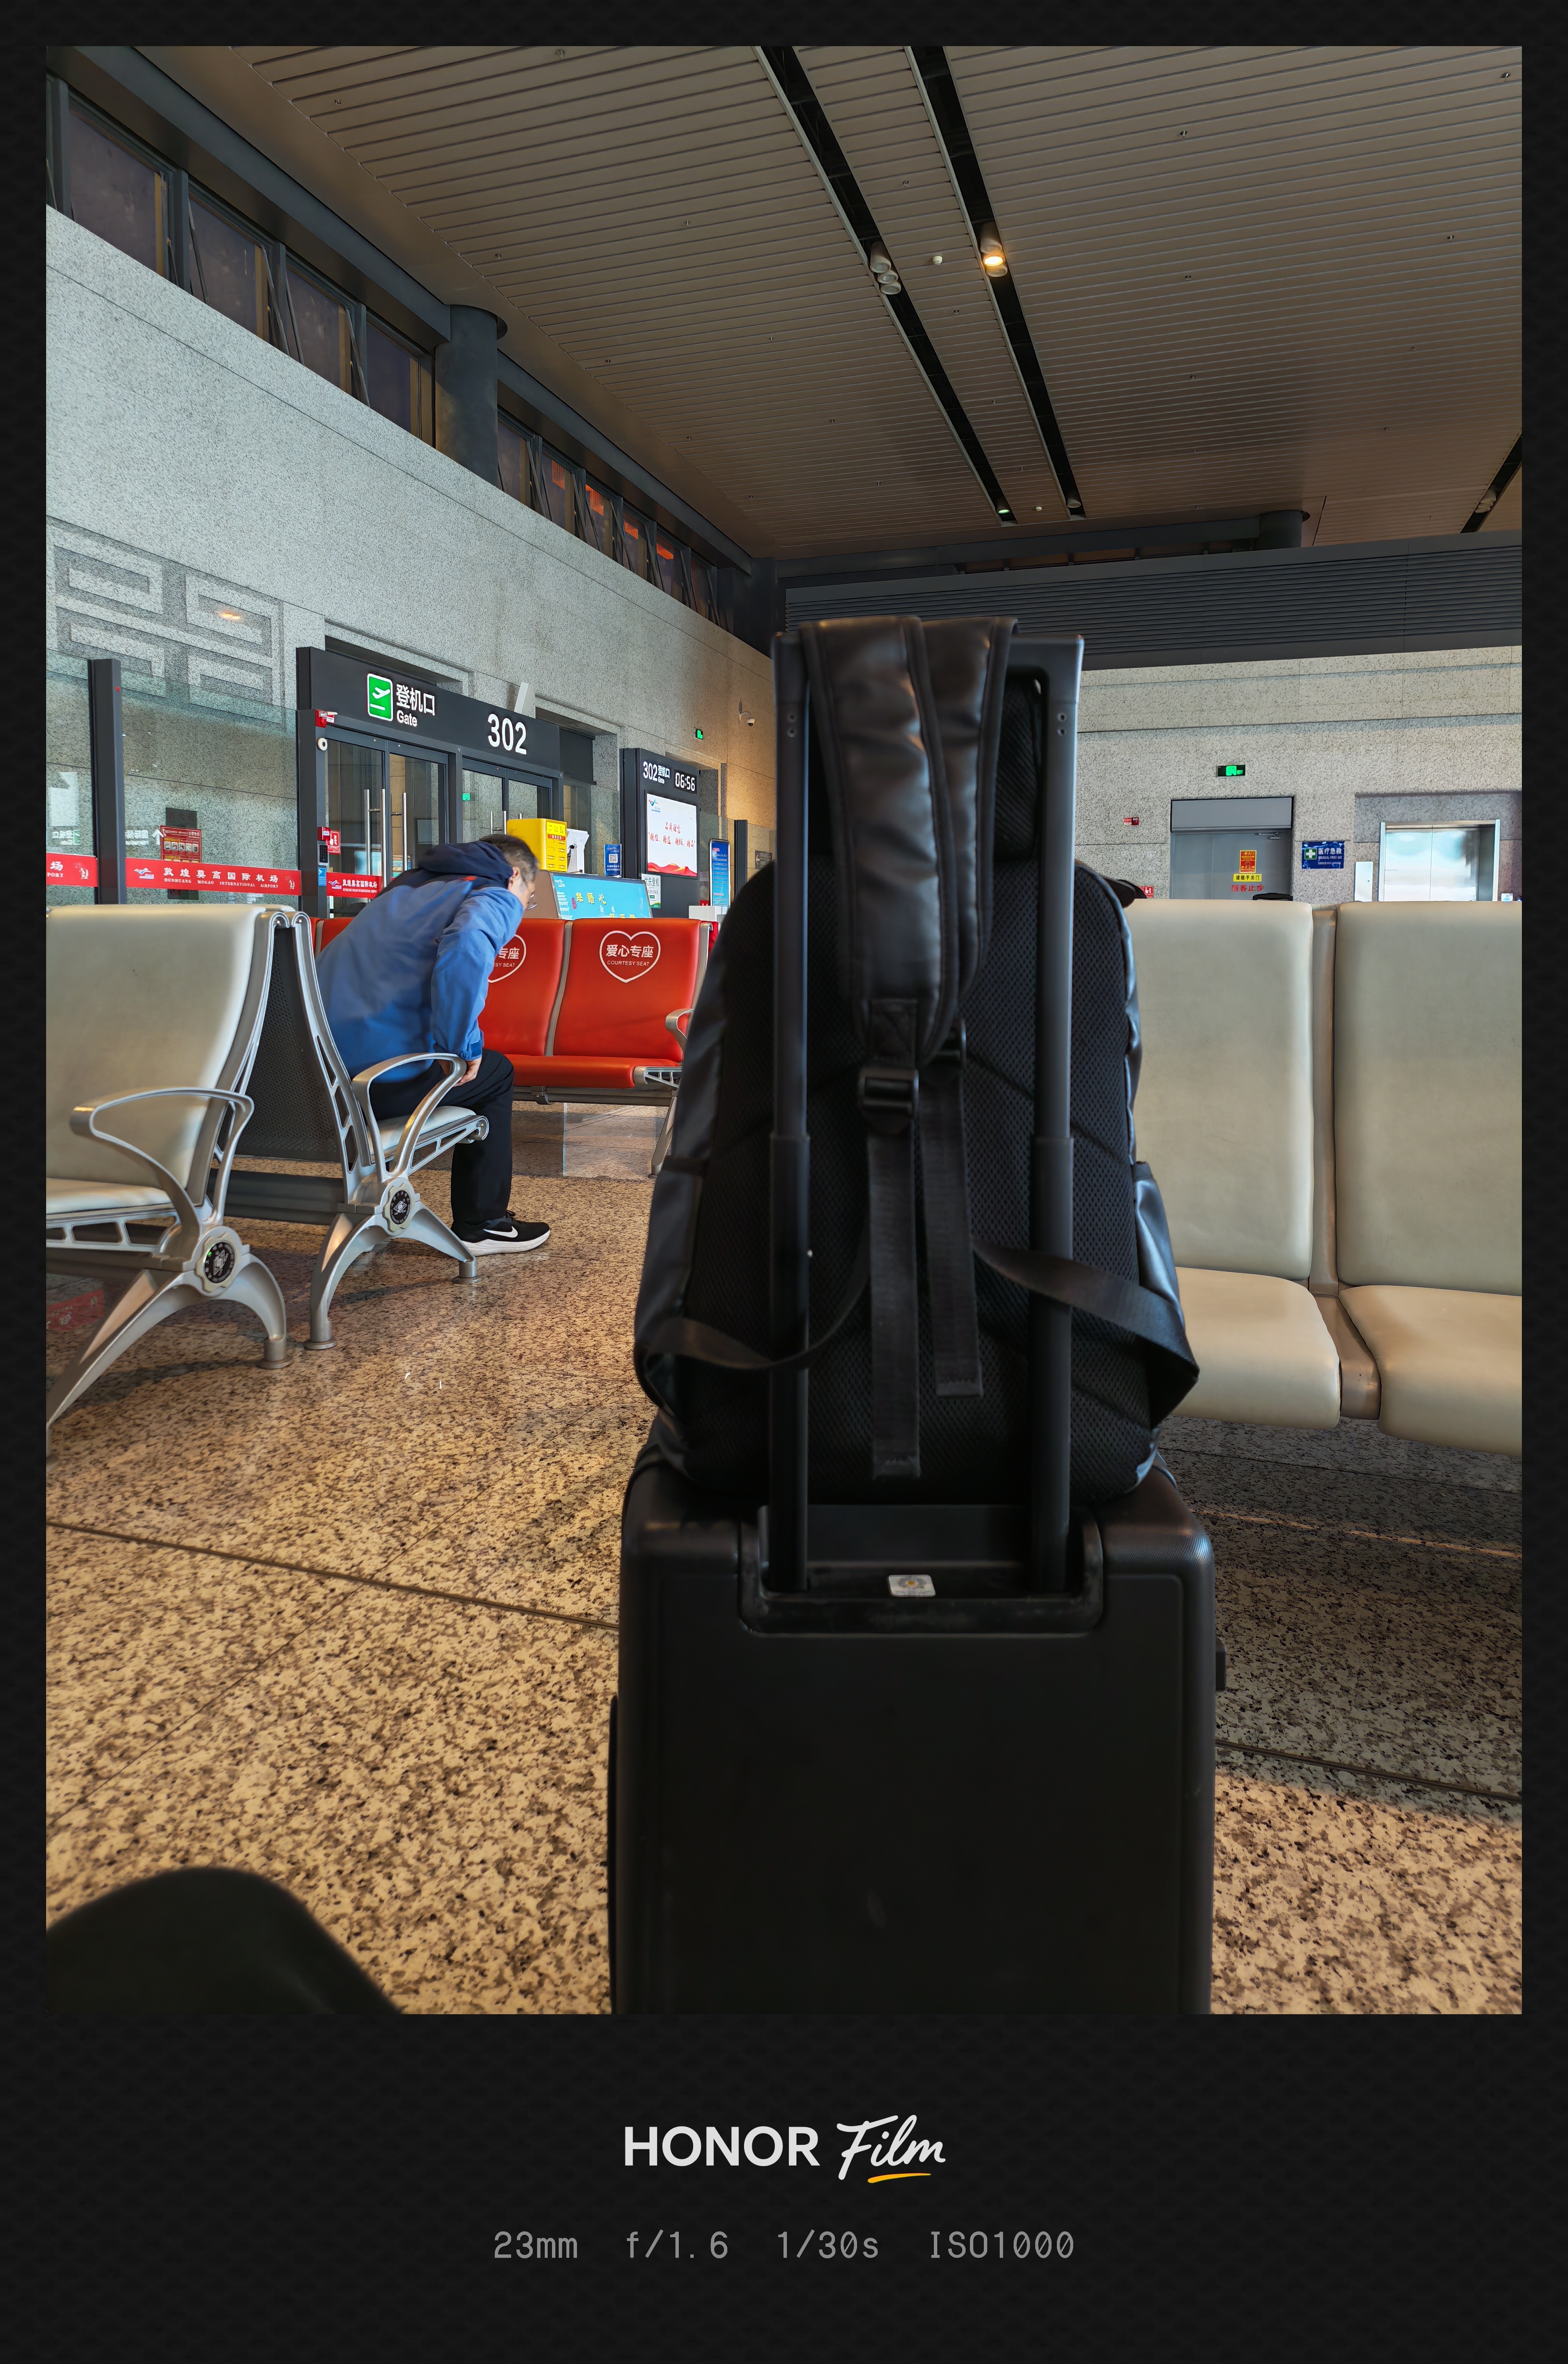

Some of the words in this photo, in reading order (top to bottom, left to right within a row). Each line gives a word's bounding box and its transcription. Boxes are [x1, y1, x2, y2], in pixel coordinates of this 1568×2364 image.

[396, 684, 435, 716] 登机口
[396, 711, 418, 727] Gate
[488, 714, 527, 755] 302
[643, 761, 658, 781] 302
[675, 772, 695, 791] 06:56
[50, 861, 63, 871] 场
[163, 867, 278, 883] 敦煌莫高国际机场
[605, 944, 654, 958] 爱心专座
